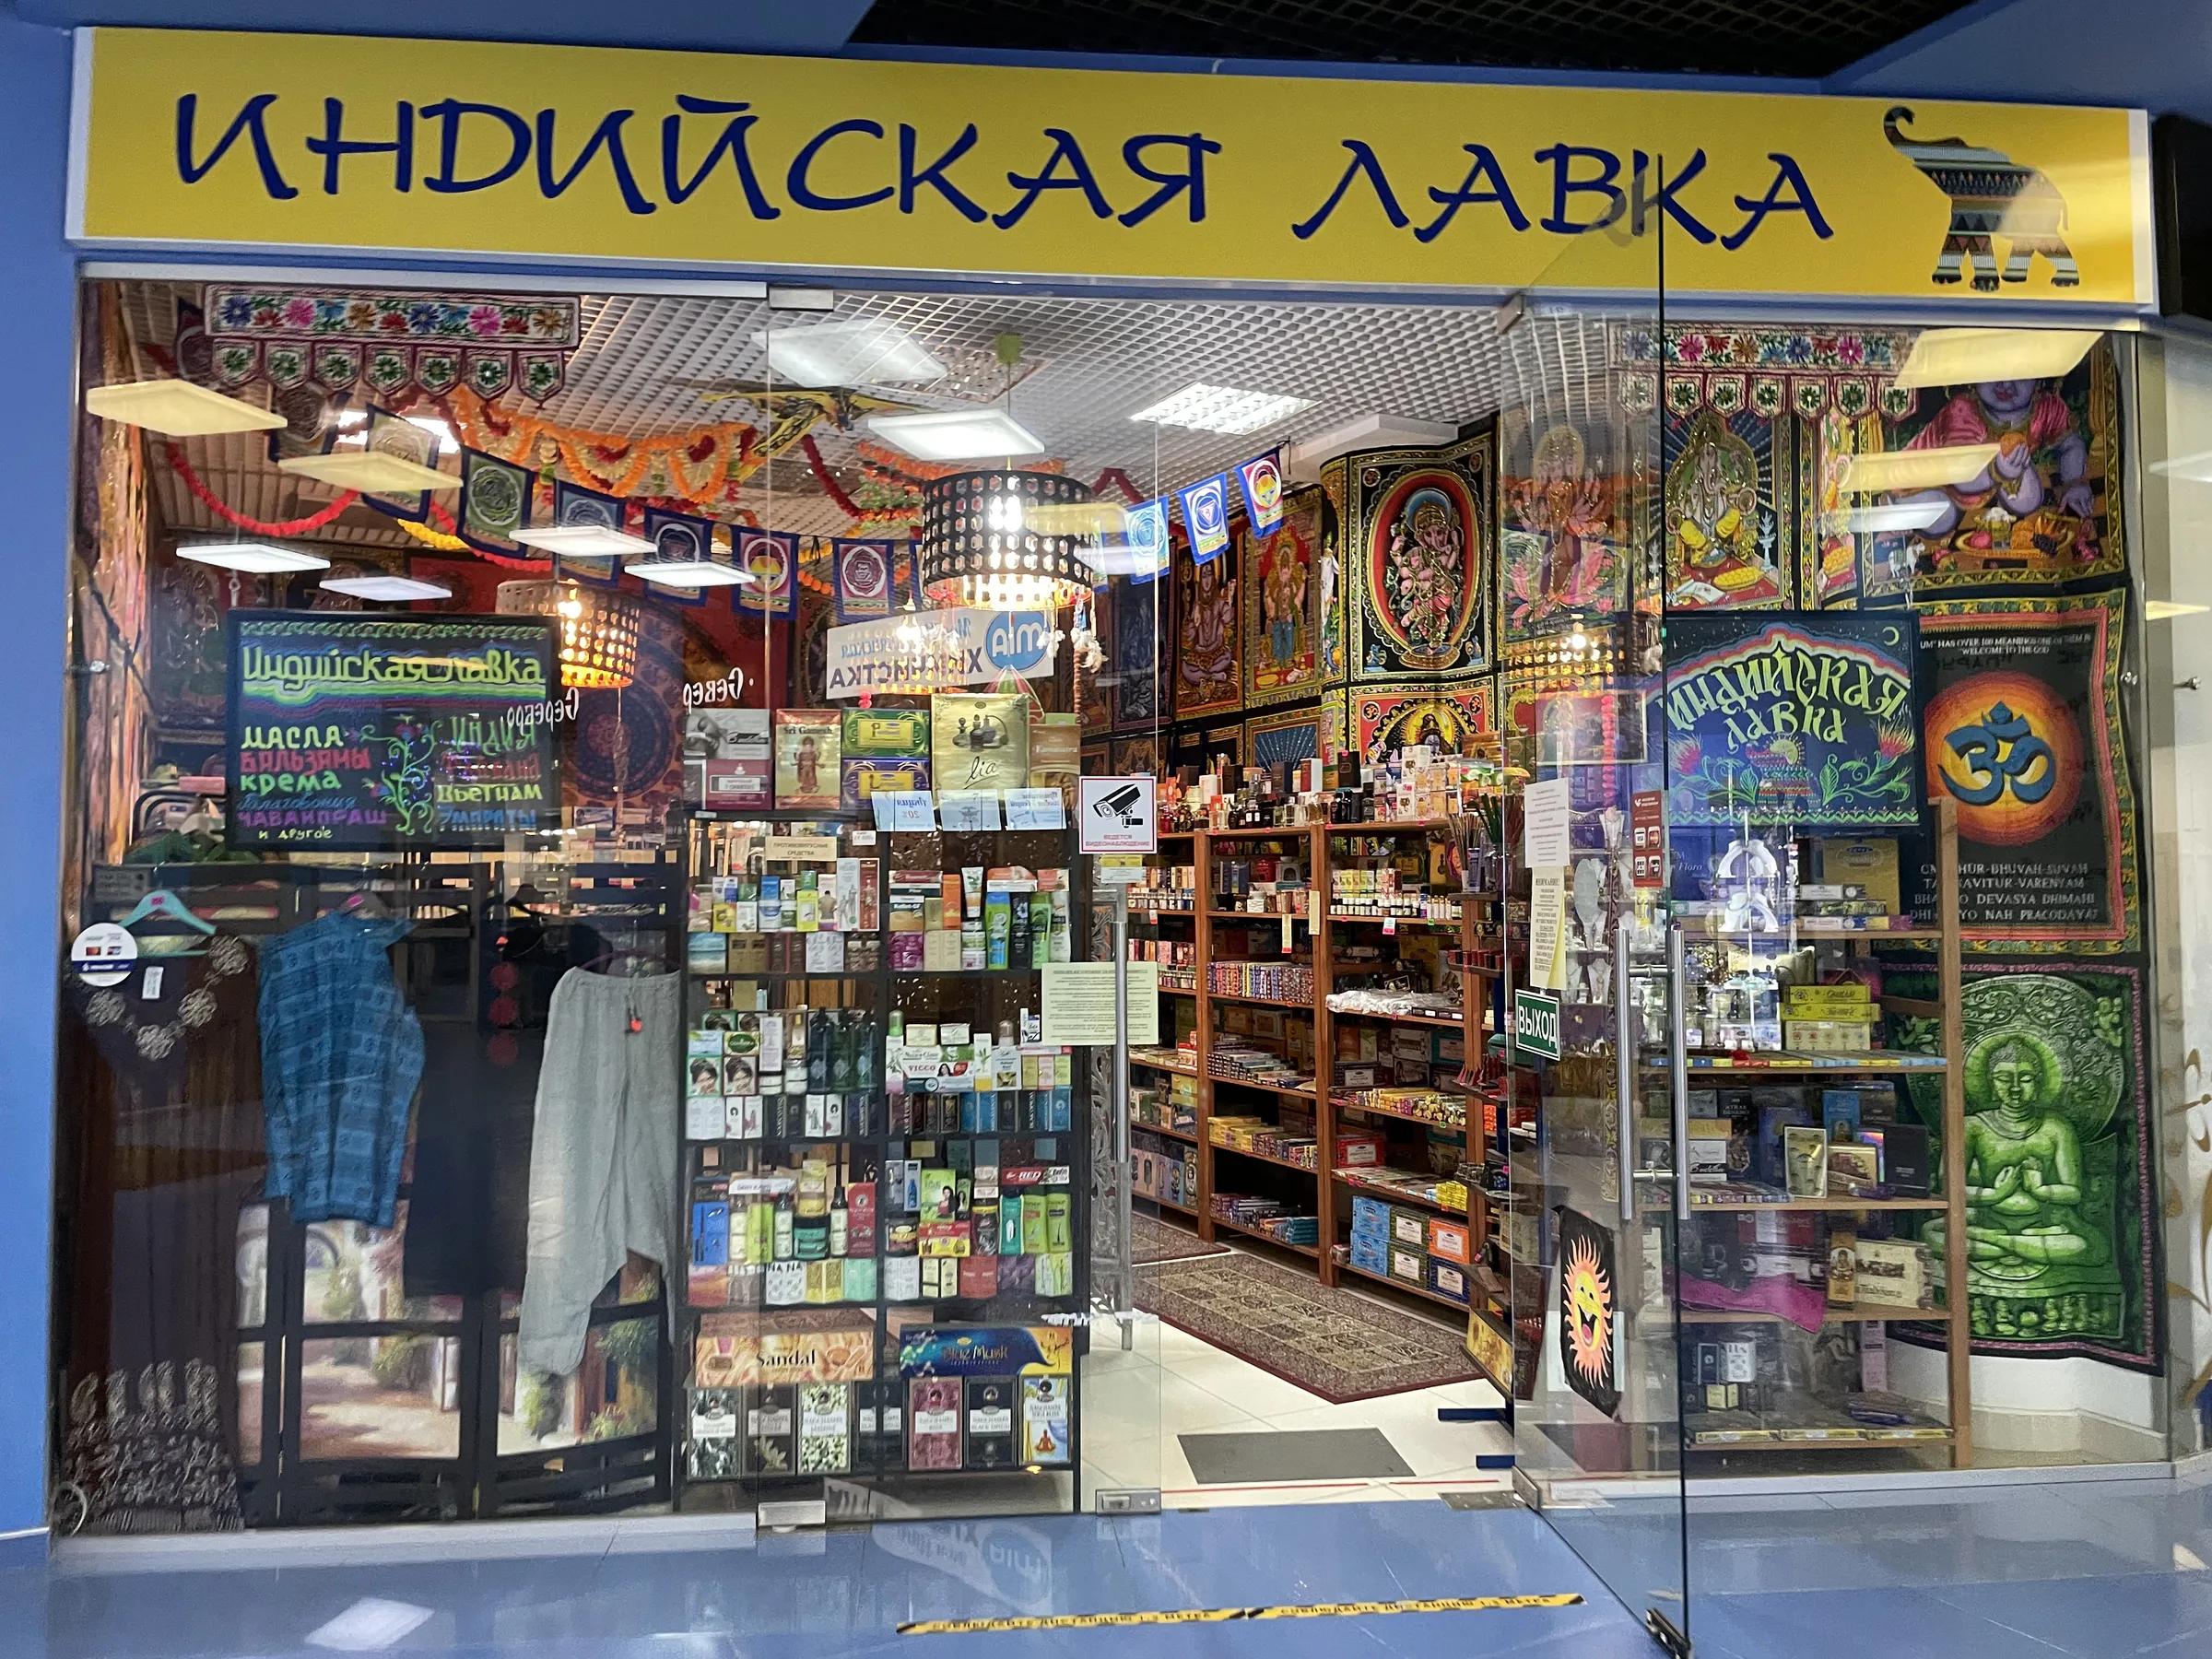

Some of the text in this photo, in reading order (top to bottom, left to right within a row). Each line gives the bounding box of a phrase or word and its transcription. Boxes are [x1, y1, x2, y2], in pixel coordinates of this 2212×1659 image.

[176, 93, 1834, 251] ИНДИЙСКАЯ ЛАВКА
[783, 726, 796, 735] Sri
[1678, 862, 1703, 871] Flora
[1957, 863, 2088, 876] HUR-BHUVAH-SUVAH
[1976, 893, 2036, 905] DEVASYA
[1984, 909, 2013, 921] NAH
[1519, 1006, 1558, 1050] ВЫХОД
[908, 1065, 936, 1073] VICCO
[1018, 1171, 1041, 1180] RED
[757, 1348, 817, 1367] Sandal
